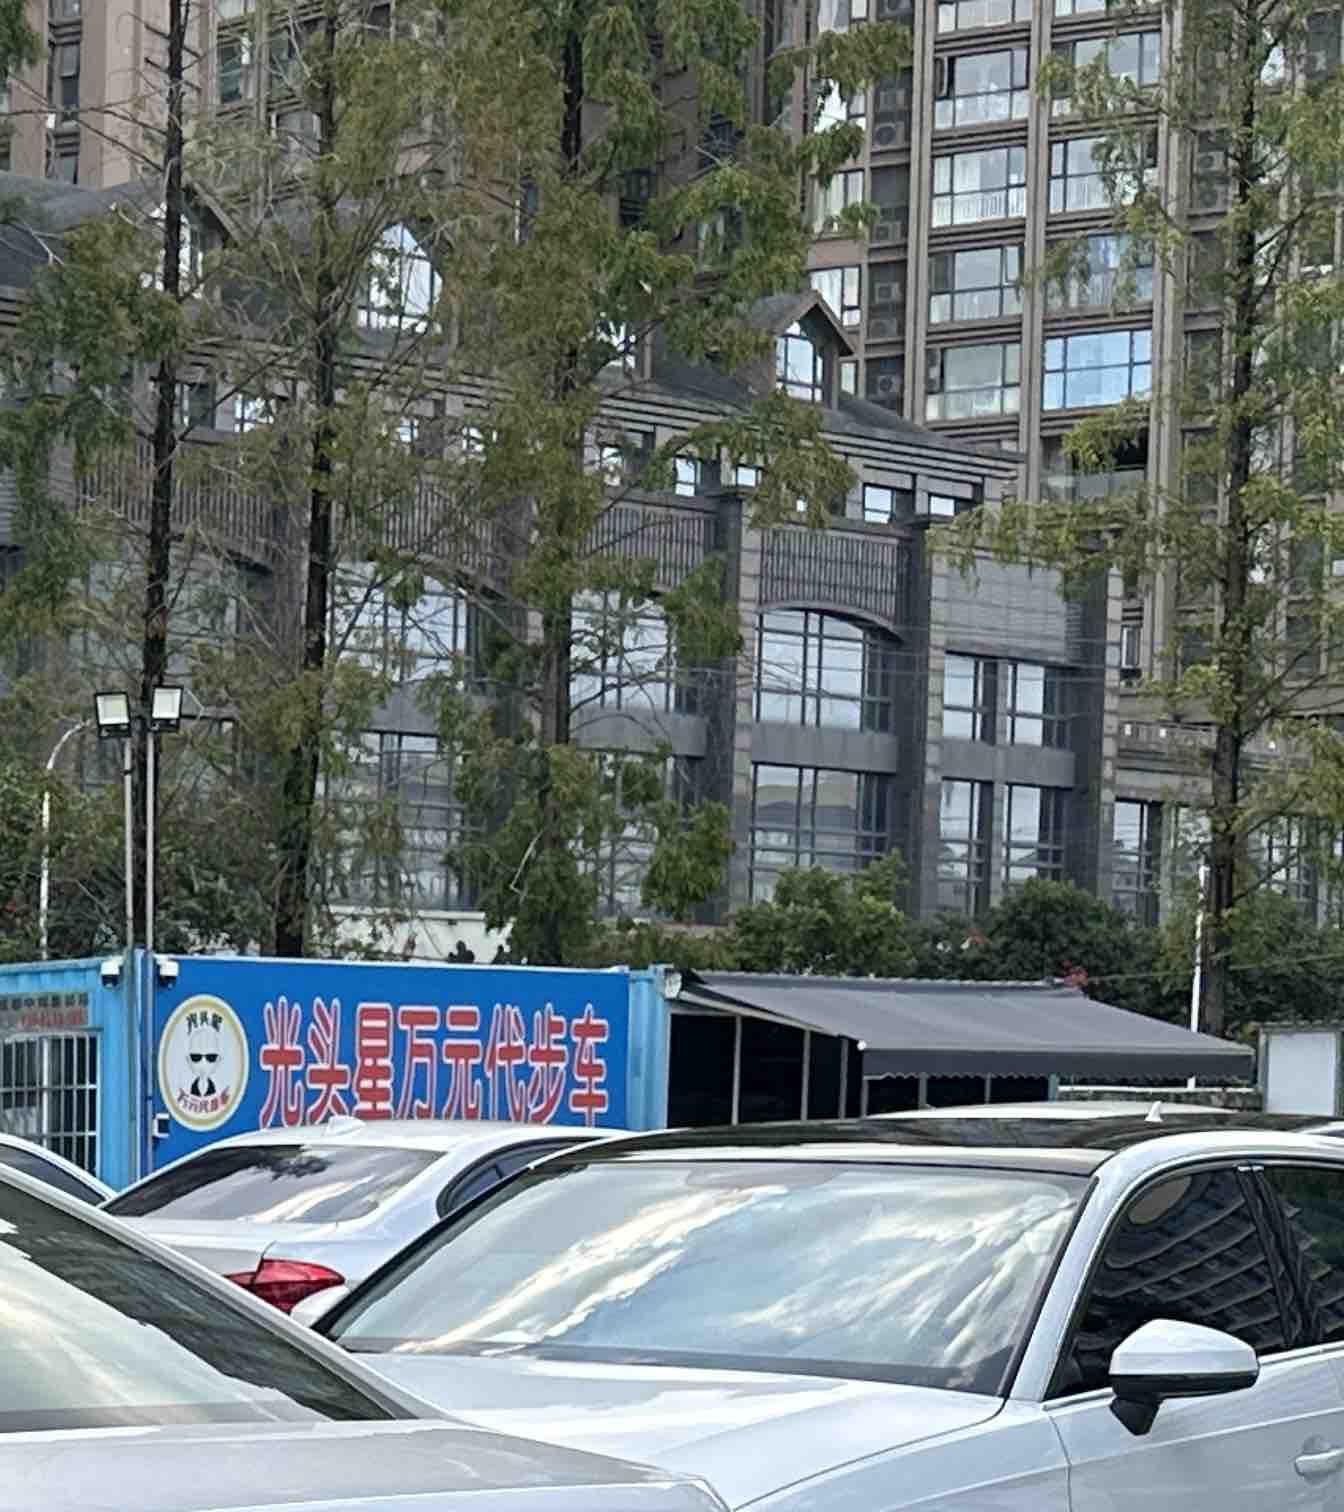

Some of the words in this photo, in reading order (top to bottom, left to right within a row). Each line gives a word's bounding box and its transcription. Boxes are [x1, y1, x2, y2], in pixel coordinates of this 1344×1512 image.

[259, 996, 609, 1126] 光头星万元代步车
